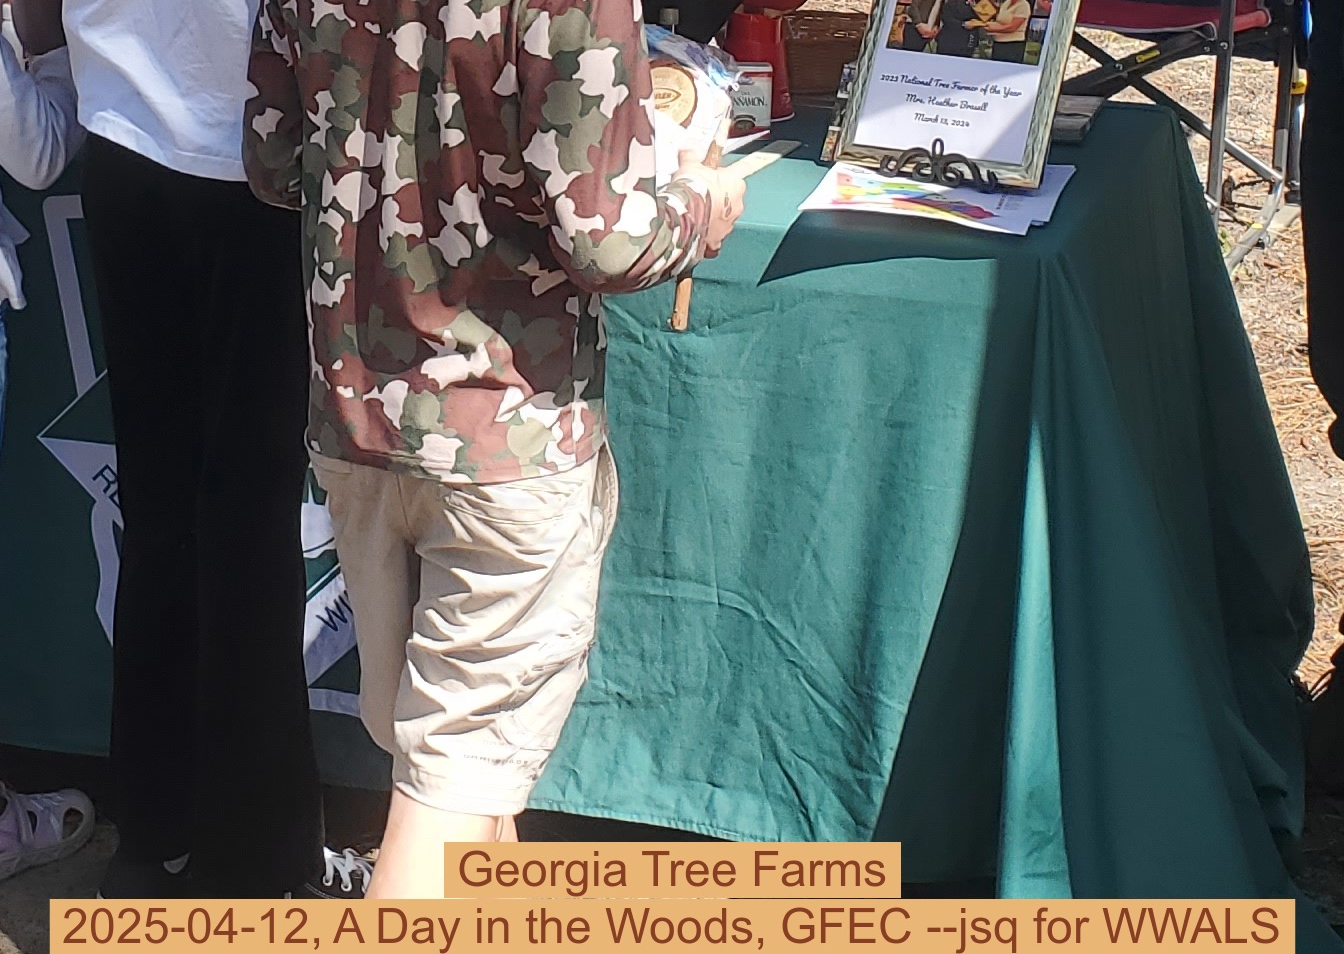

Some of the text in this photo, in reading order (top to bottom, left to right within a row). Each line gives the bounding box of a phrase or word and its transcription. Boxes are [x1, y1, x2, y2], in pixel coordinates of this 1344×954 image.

[900, 74, 933, 87] National
[934, 78, 950, 89] Tree
[951, 81, 978, 92] Farmer
[979, 84, 988, 95] of
[989, 84, 1001, 95] the
[1003, 86, 1022, 98] Year
[914, 112, 939, 124] March
